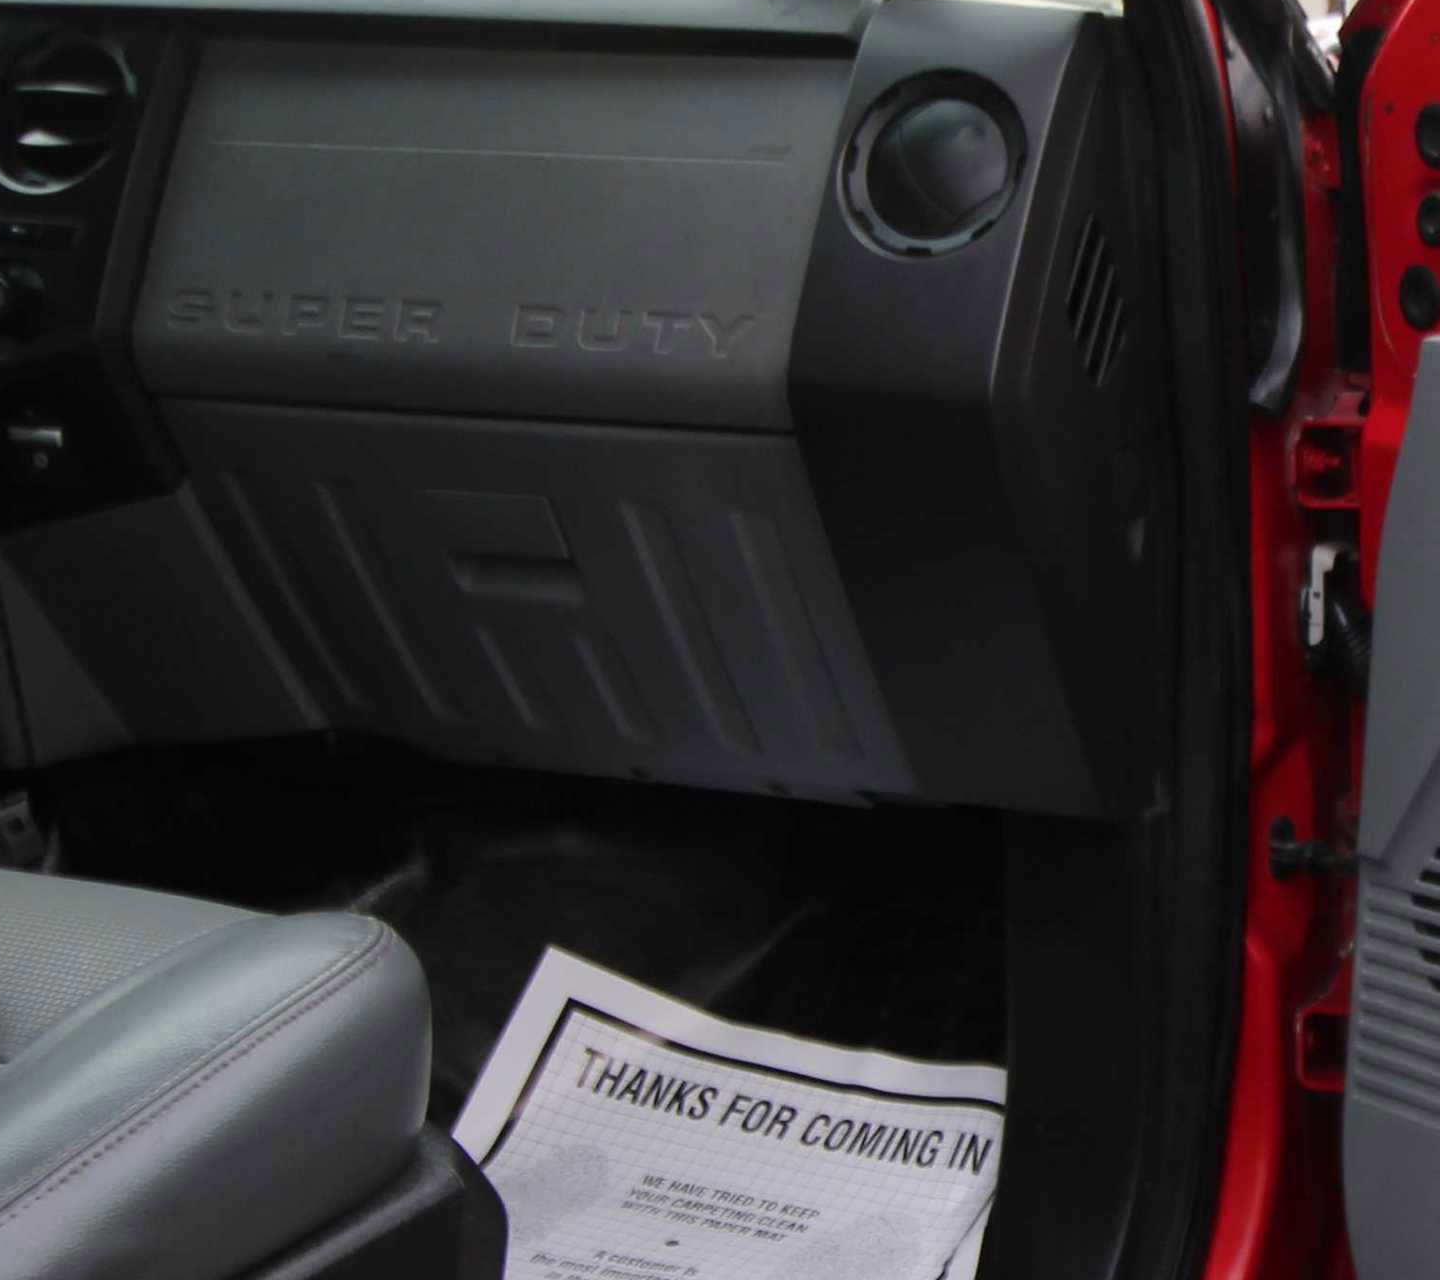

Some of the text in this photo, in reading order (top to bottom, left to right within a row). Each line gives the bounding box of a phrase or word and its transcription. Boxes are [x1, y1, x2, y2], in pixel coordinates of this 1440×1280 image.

[166, 288, 755, 359] SUPER DUTY
[576, 1046, 994, 1176] THANKS FOR COMING IN
[628, 1187, 810, 1234] YOUR CARPETING CLEAN
[641, 1174, 821, 1221] WE HAVE TRIED TO KEEP
